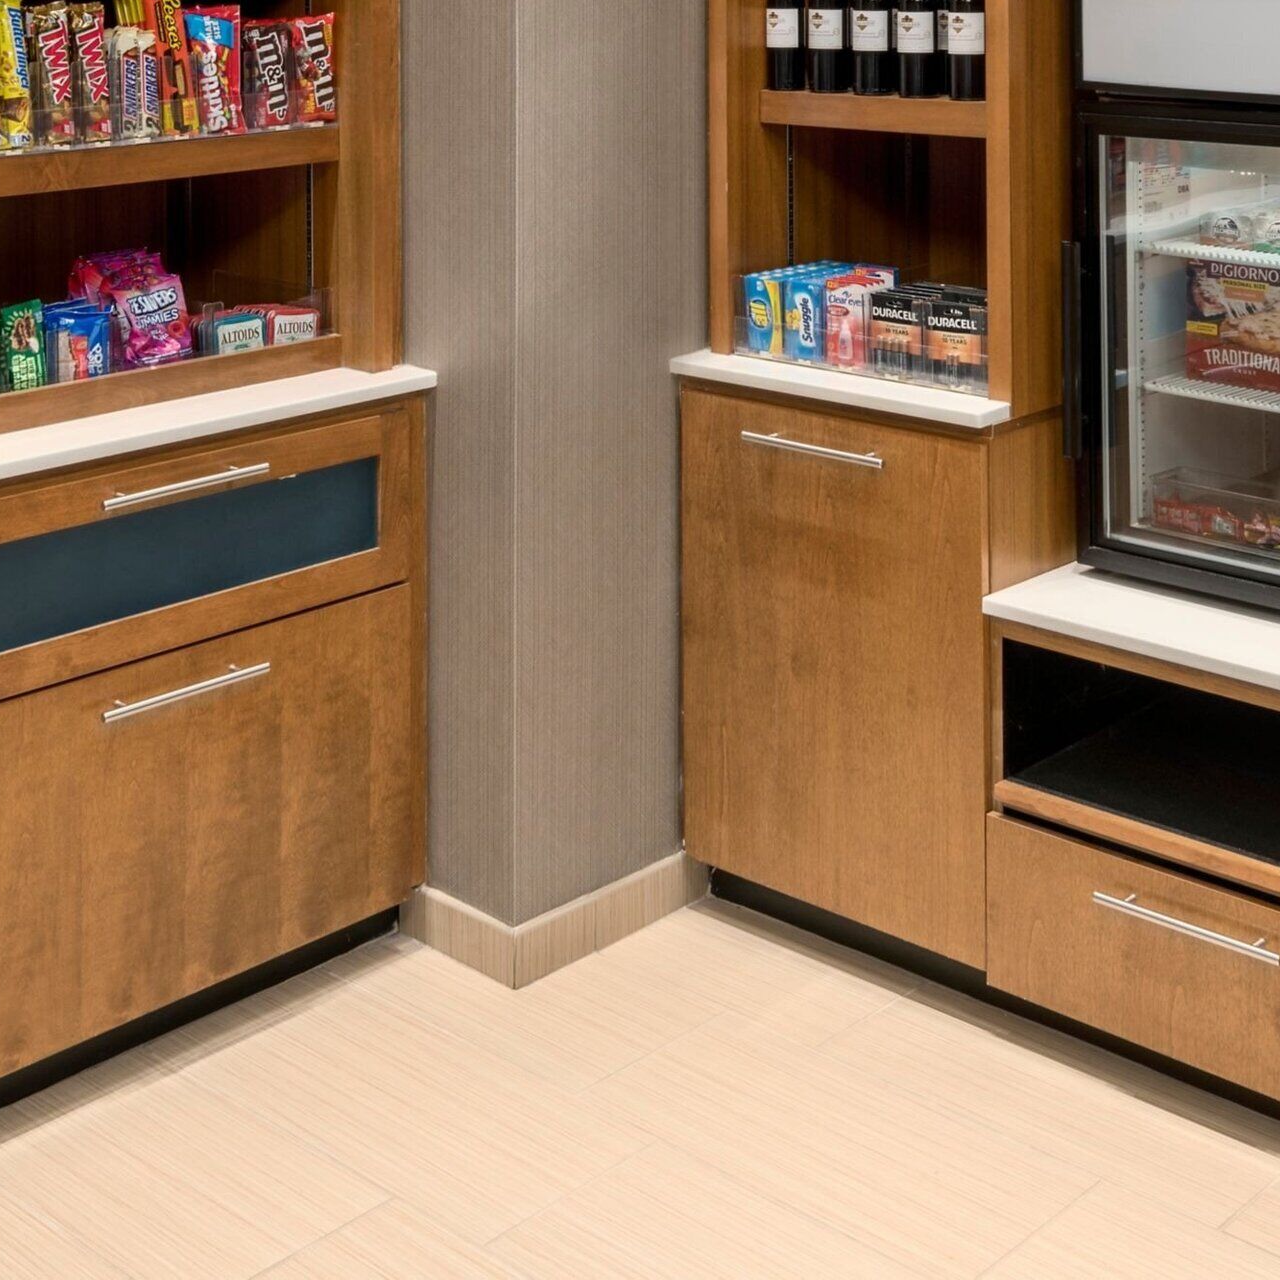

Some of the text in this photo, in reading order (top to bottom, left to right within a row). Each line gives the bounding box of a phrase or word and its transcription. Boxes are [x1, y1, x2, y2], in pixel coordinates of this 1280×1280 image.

[212, 19, 223, 40] SIZE
[8, 7, 30, 90] Butterfinger
[38, 19, 71, 105] TWIX
[76, 17, 110, 104] TWIX
[124, 57, 138, 117] SNICKERS
[144, 56, 158, 116] SNICKERS
[200, 49, 229, 132] Skittles
[1210, 262, 1280, 283] DIGIORNO
[1222, 279, 1267, 291] PERSONAL SIZE
[138, 288, 178, 313] SAVERS
[827, 293, 847, 307] Clear
[135, 308, 179, 329] GUMMIES
[753, 300, 770, 327] all
[800, 296, 814, 344] Snuggle
[872, 305, 919, 323] DURACELL
[927, 315, 978, 332] DURACELL
[220, 326, 260, 345] ALTOIDS
[276, 320, 315, 335] ALTOIDS
[893, 328, 910, 337] YEARS
[949, 337, 968, 346] YEARS
